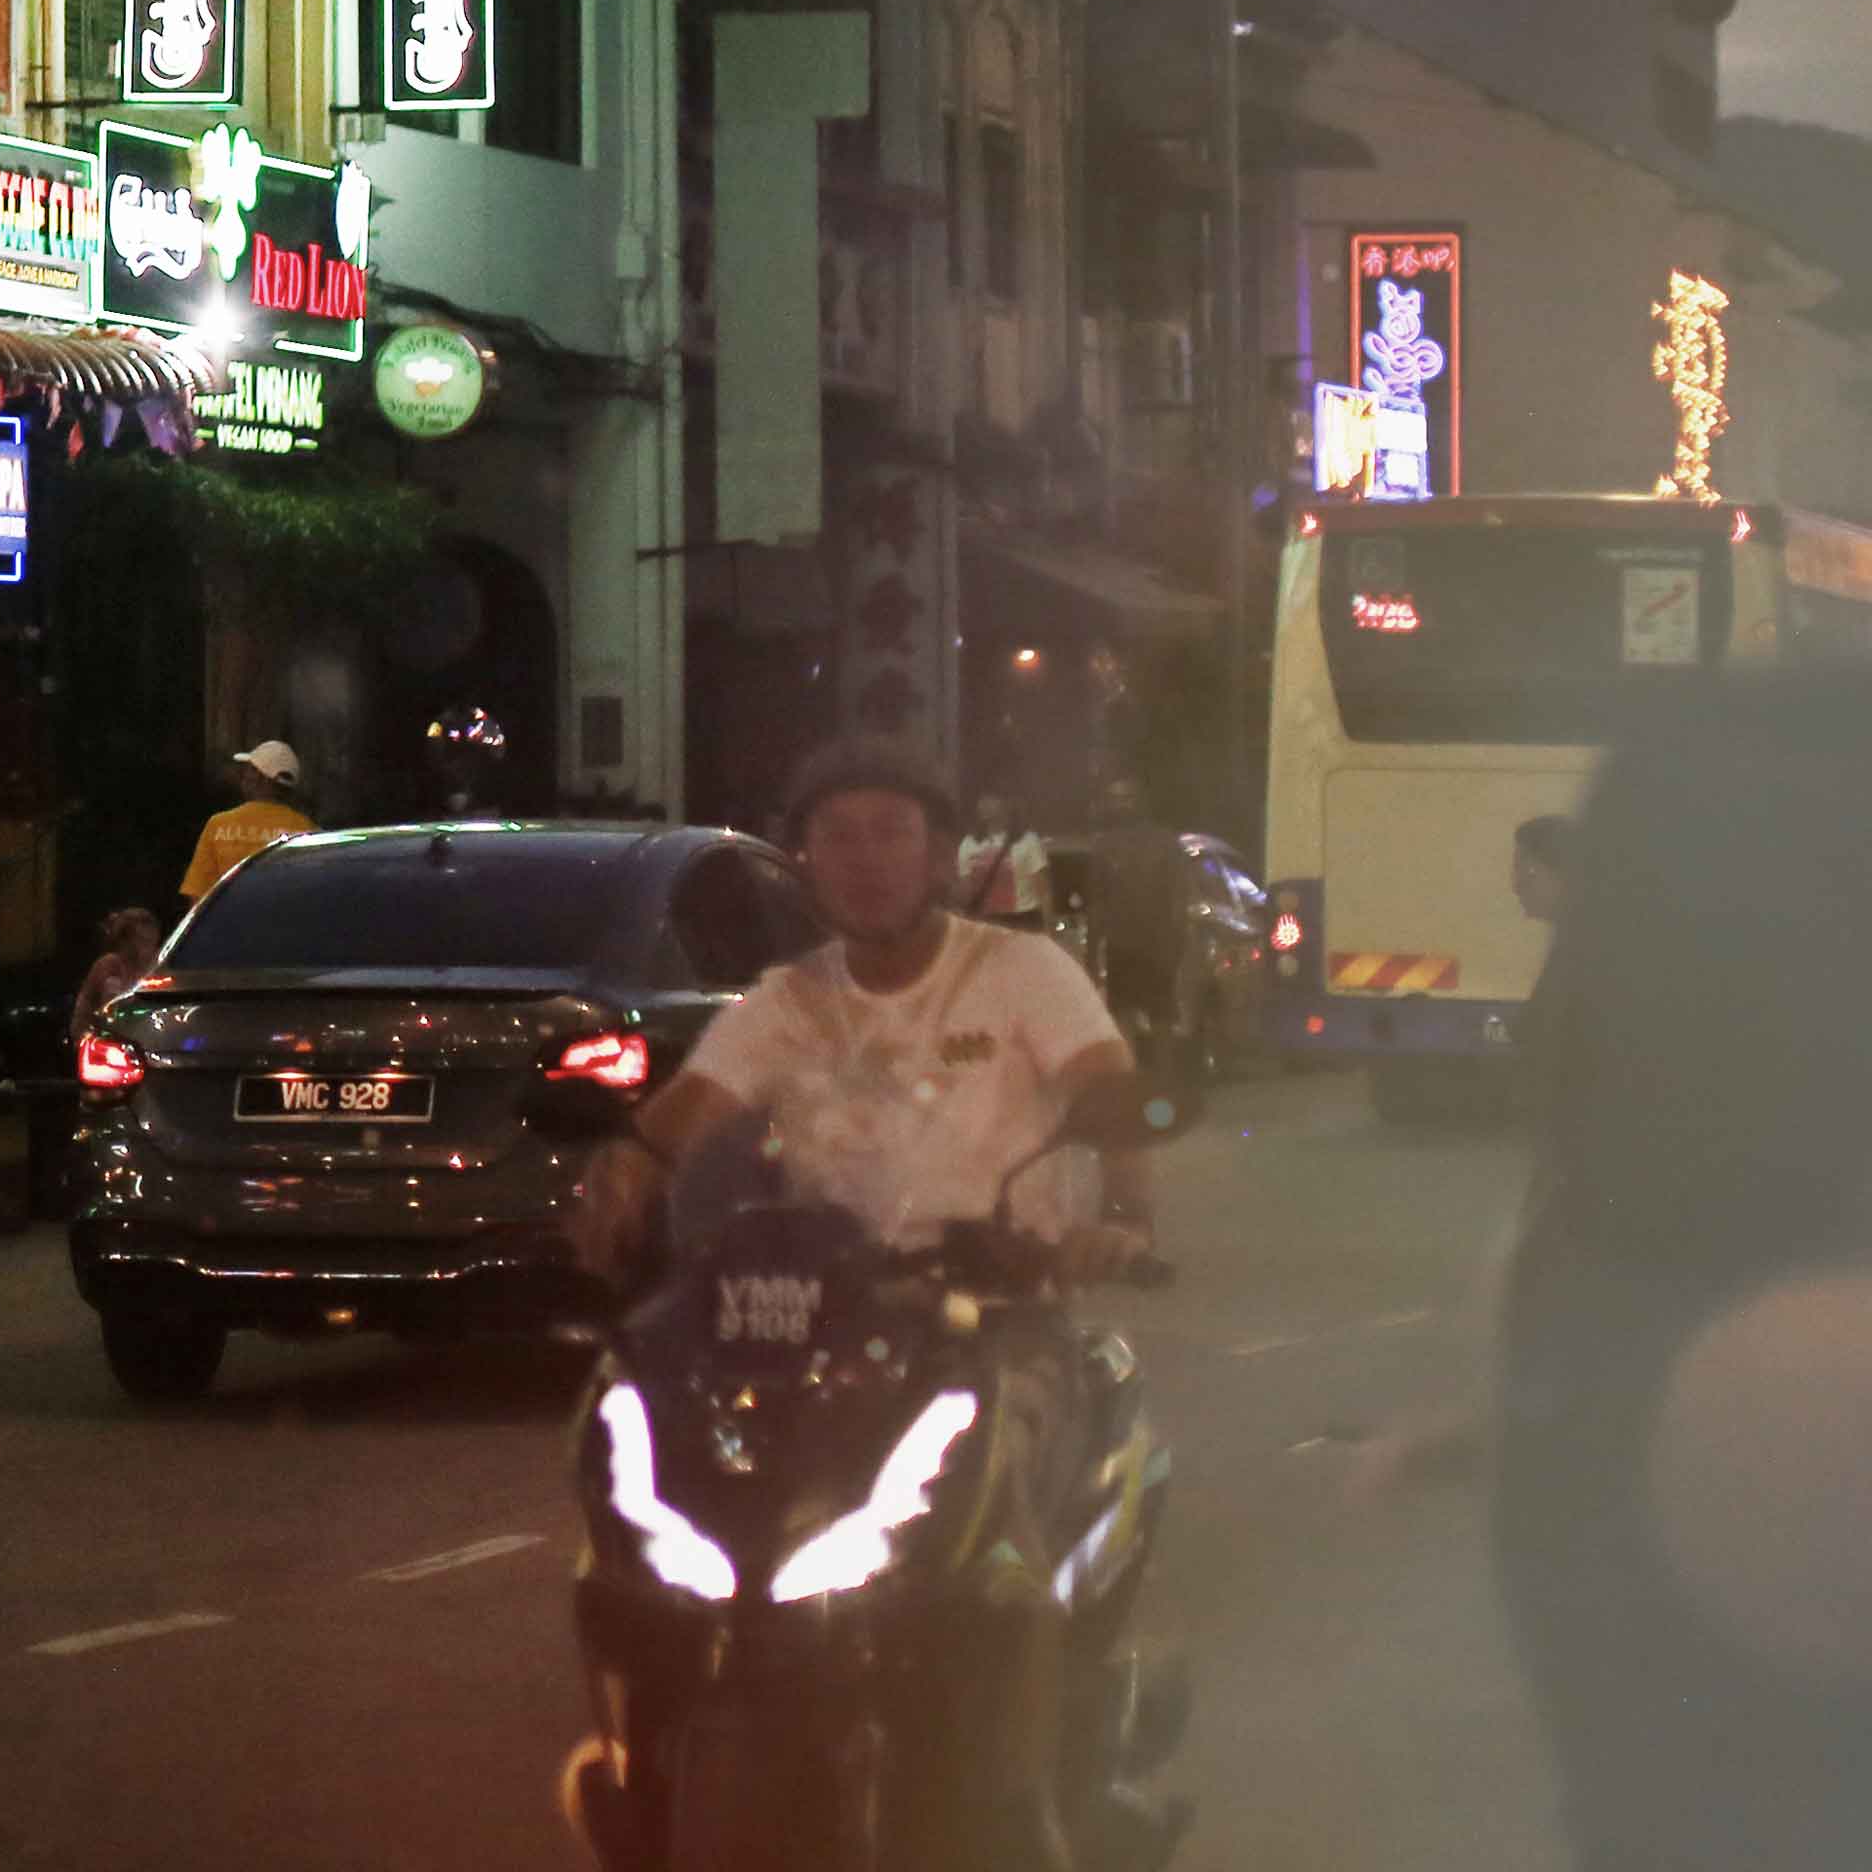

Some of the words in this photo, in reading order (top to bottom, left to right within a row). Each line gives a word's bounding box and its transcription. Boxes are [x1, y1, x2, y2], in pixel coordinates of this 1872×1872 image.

[250, 233, 307, 315] RED
[308, 243, 366, 319] LION
[281, 1081, 330, 1110] VMC
[339, 1082, 390, 1110] 928
